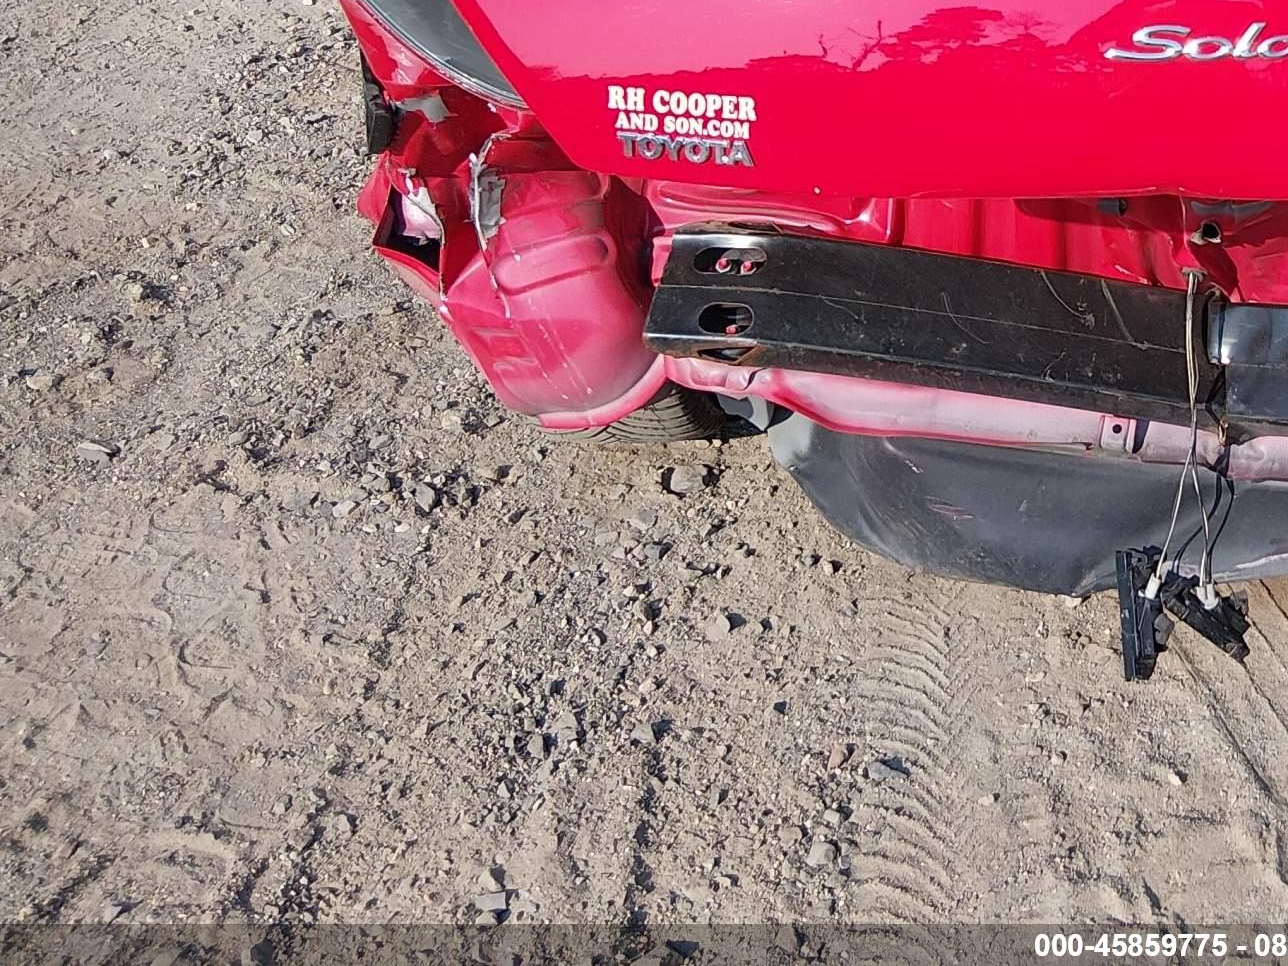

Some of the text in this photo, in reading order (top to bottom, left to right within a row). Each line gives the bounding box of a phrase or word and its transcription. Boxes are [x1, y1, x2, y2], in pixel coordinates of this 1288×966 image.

[607, 86, 757, 121] RH COOPER
[615, 111, 750, 139] AND SON.COM
[616, 132, 754, 166] TOYOTA
